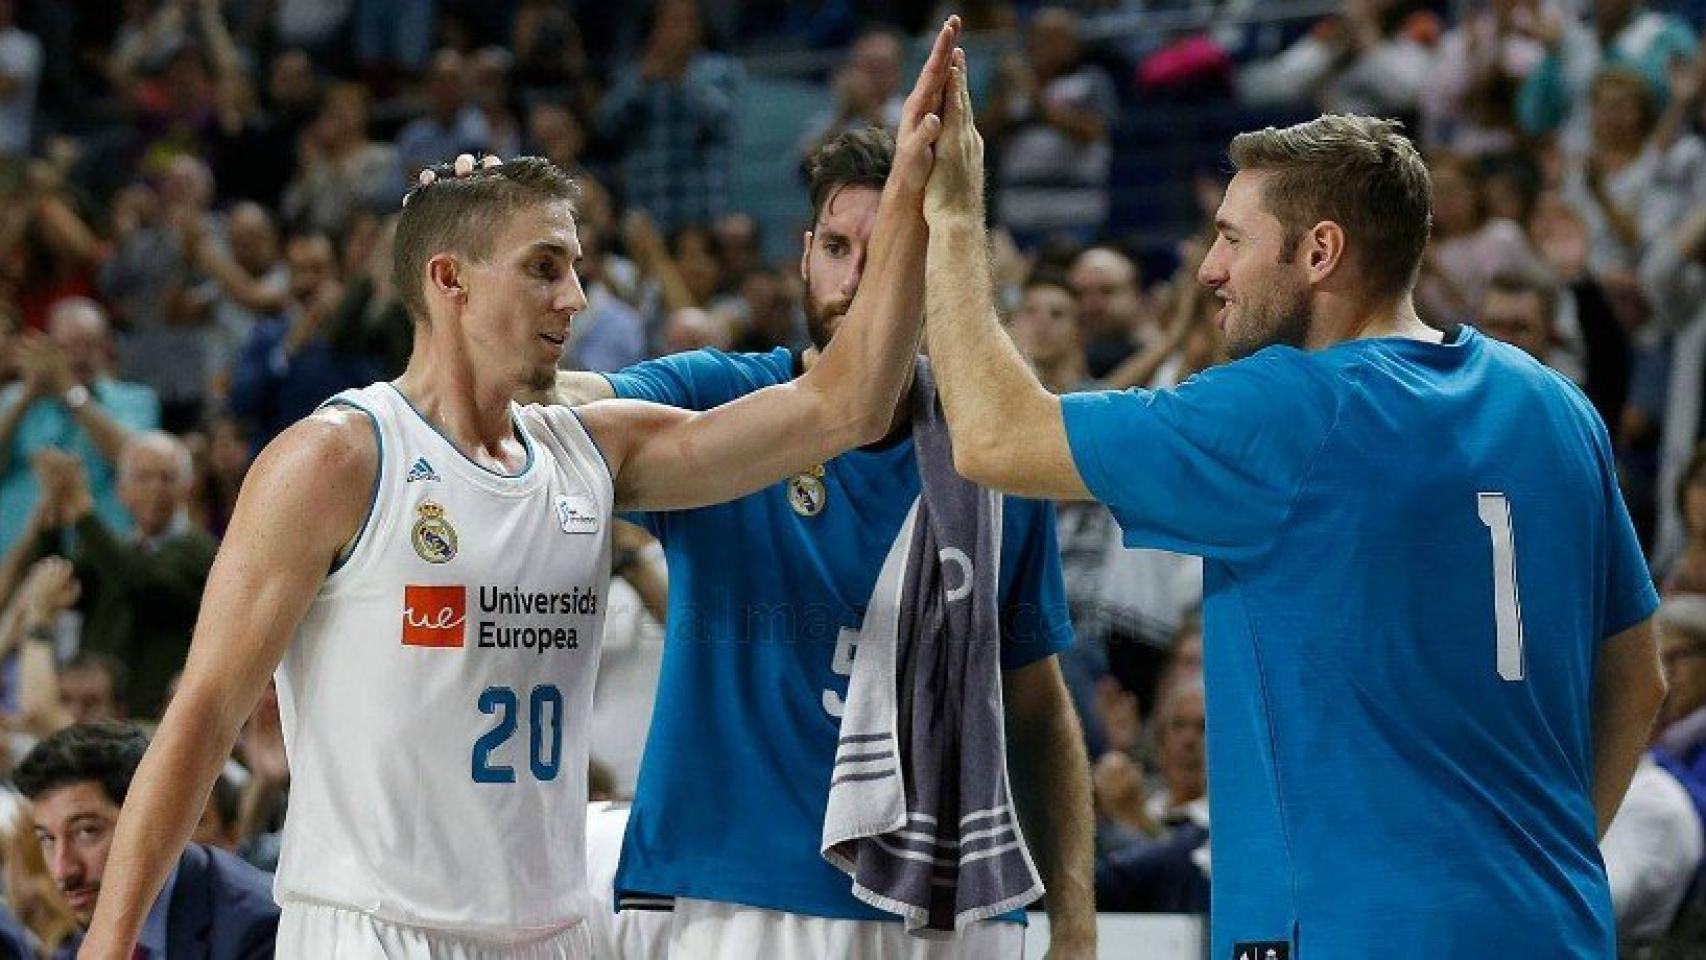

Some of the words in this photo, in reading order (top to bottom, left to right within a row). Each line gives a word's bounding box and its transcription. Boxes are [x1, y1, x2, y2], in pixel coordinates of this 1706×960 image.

[1477, 491, 1524, 682] 1
[477, 621, 579, 654] Europea
[471, 683, 563, 784] 20
